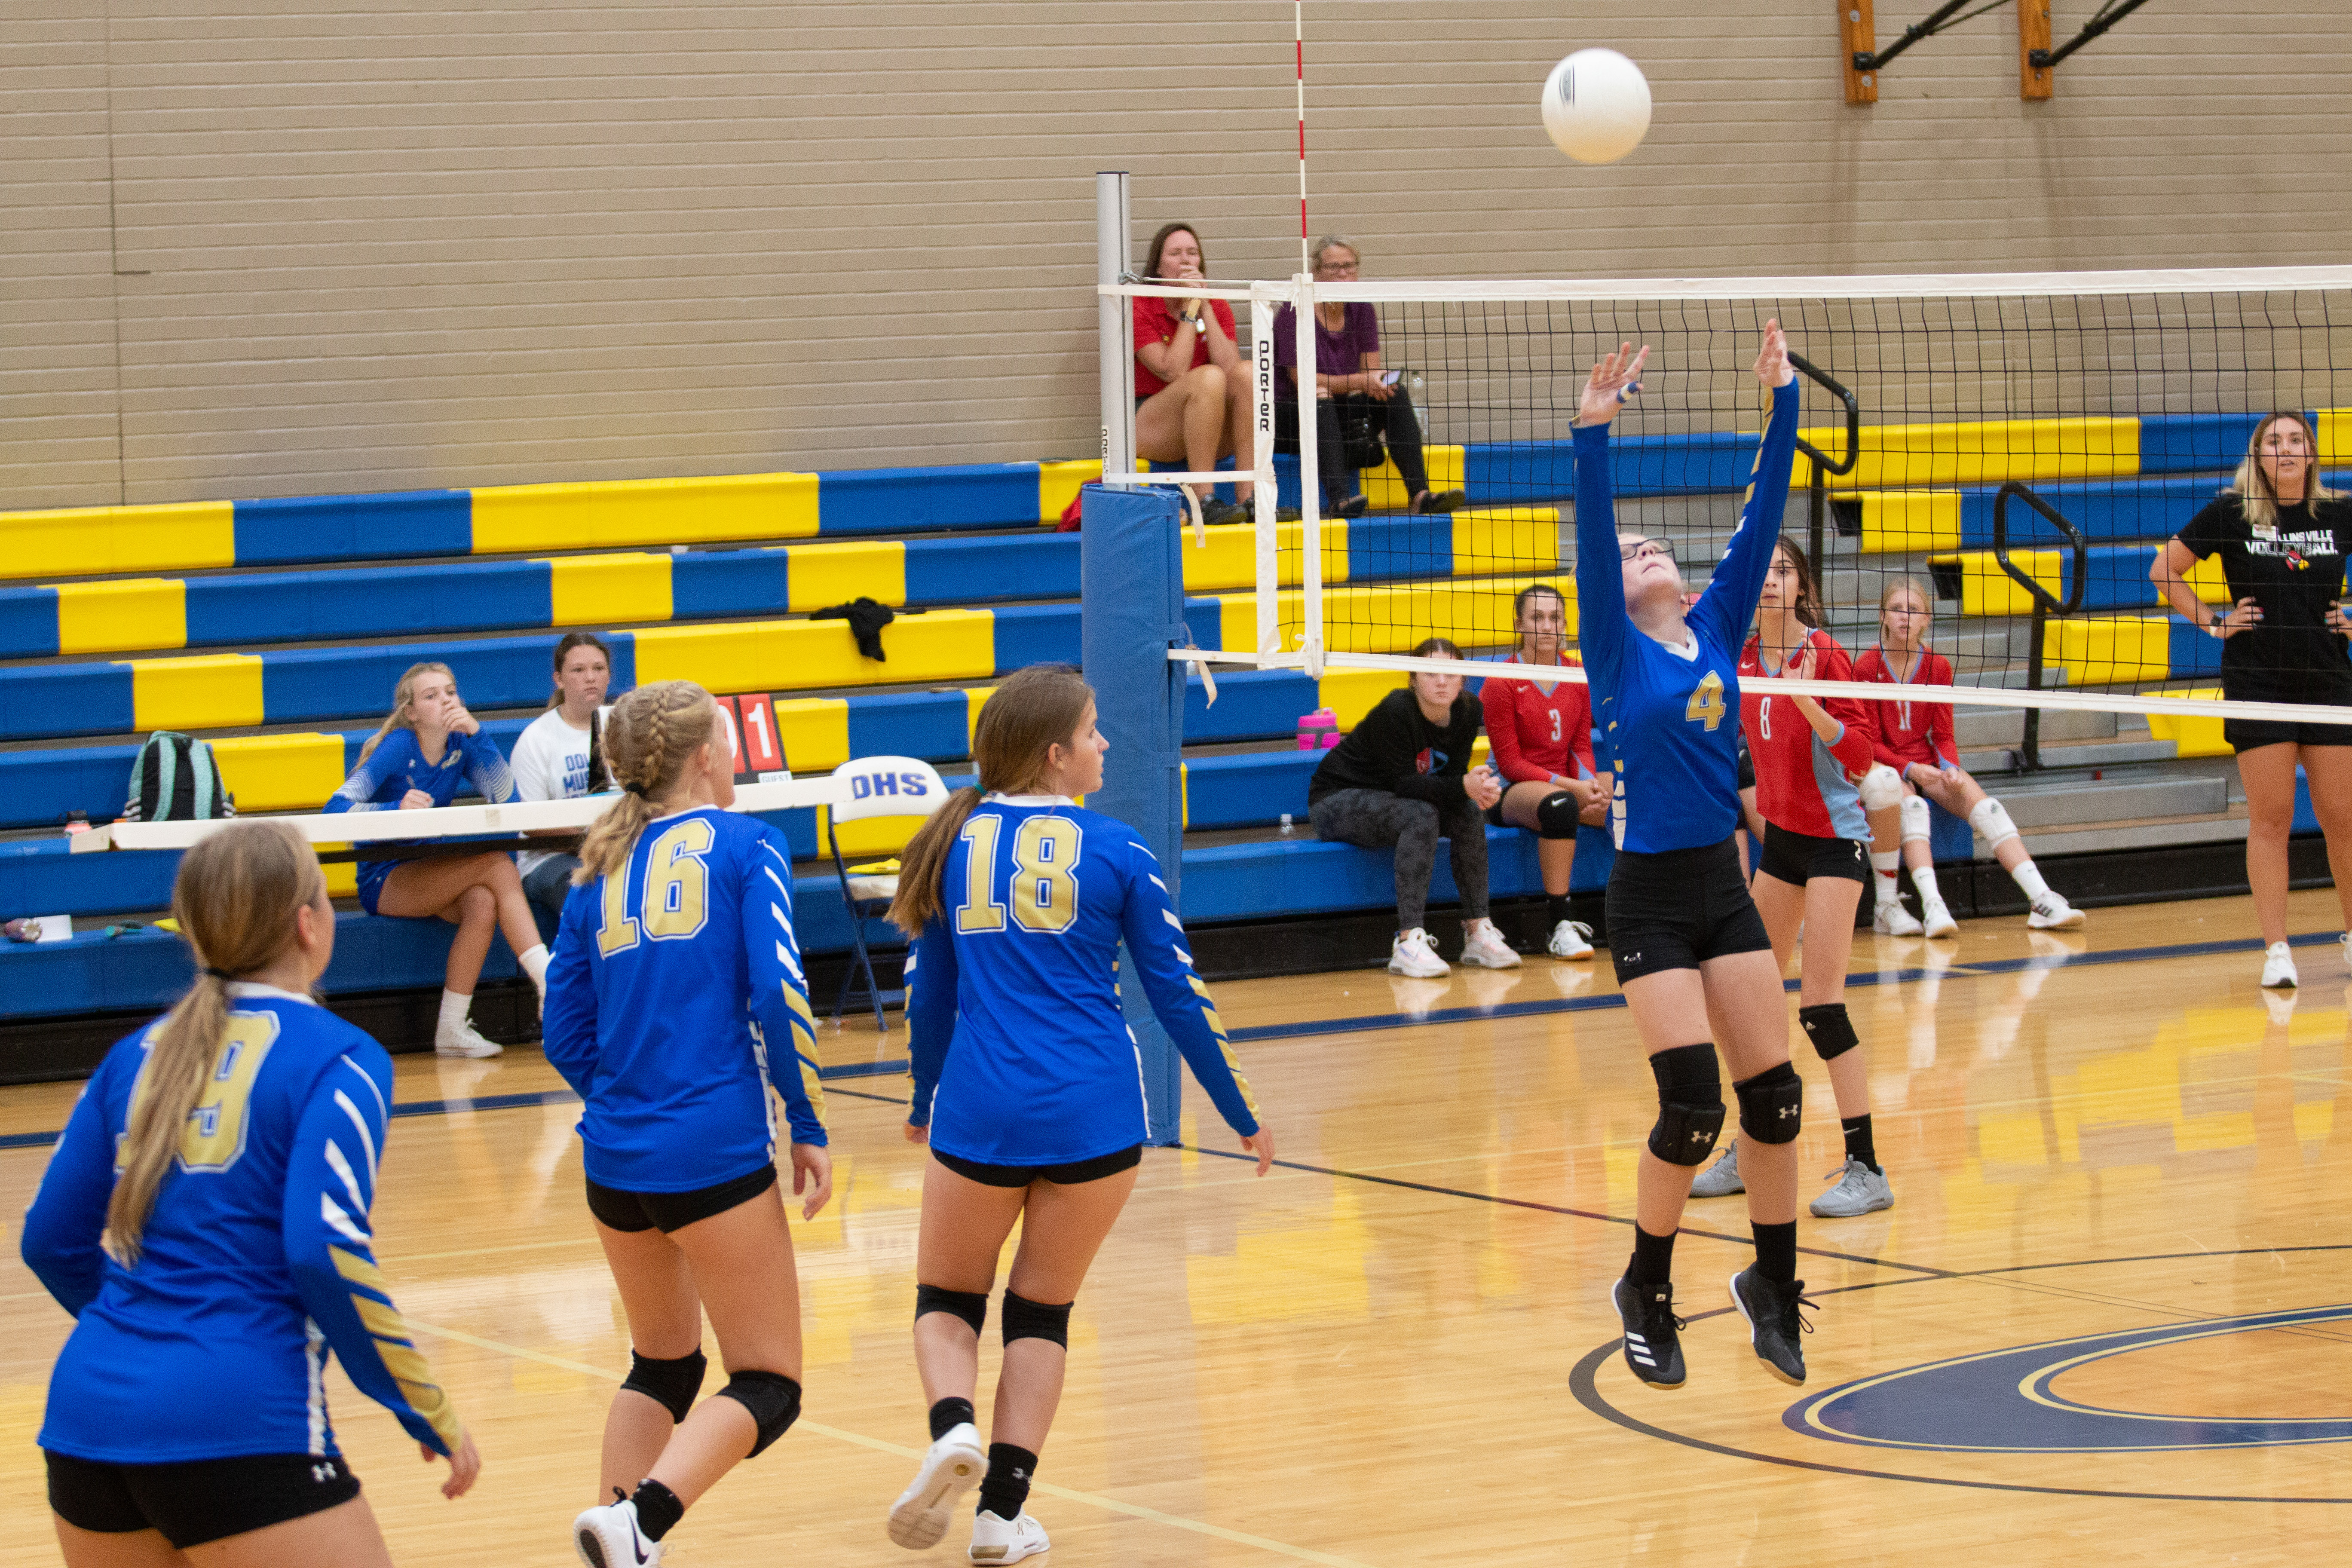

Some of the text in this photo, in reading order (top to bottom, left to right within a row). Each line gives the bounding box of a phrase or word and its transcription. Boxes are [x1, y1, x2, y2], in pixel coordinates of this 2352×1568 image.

[2245, 541, 2339, 557] VOLLEYBALL
[2266, 530, 2333, 542] LLINSVILLE
[1686, 670, 1726, 732] 4
[1549, 709, 1561, 741] 3
[1760, 696, 1771, 740] 8
[762, 774, 789, 783] GUEST
[851, 772, 928, 799] DHS
[596, 818, 716, 960] 16
[956, 814, 1082, 935] 18
